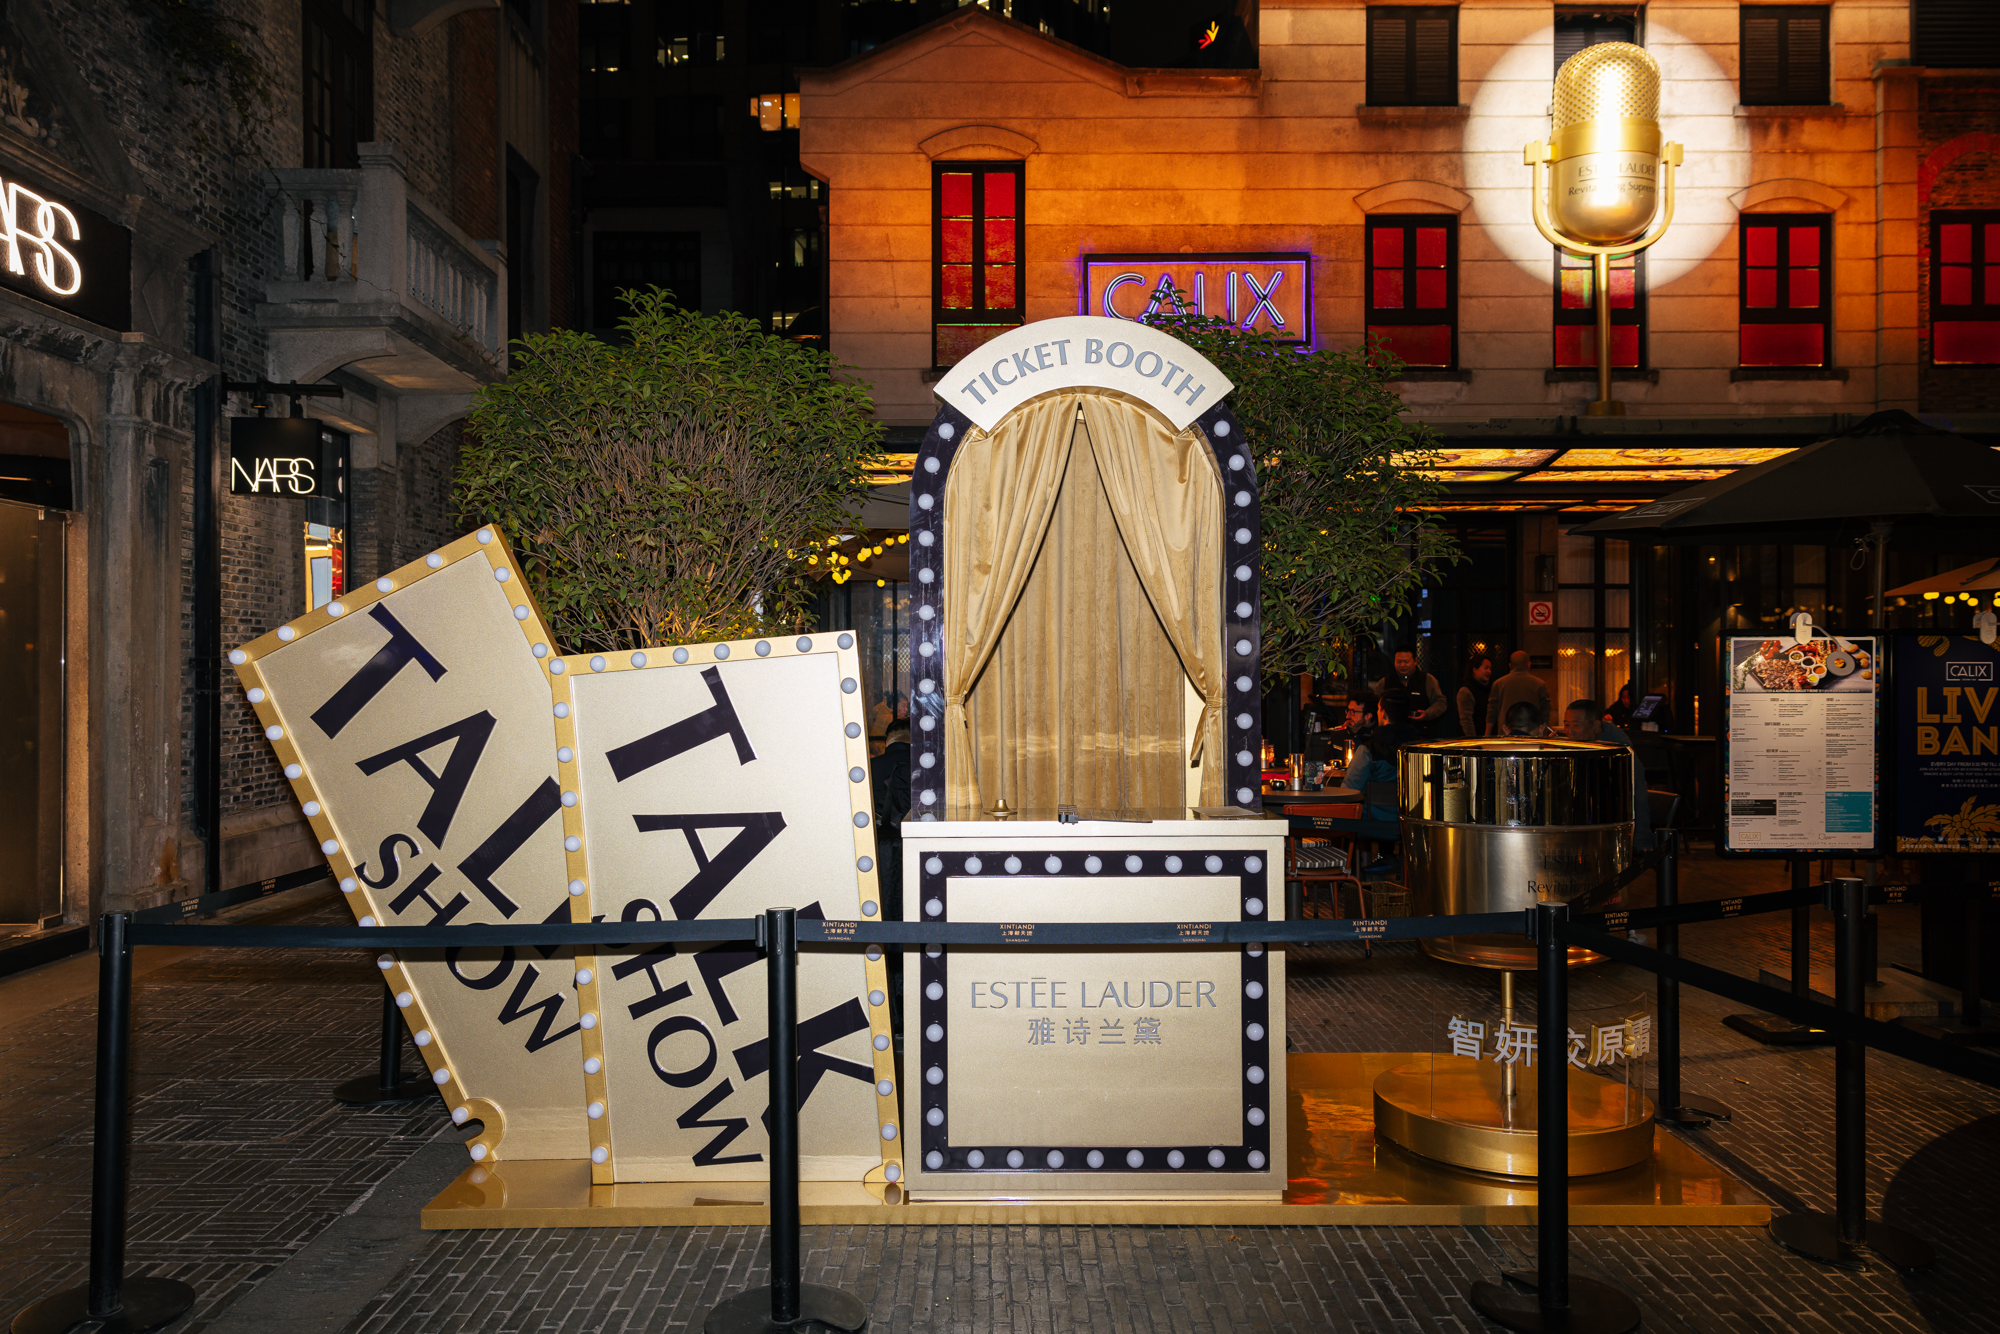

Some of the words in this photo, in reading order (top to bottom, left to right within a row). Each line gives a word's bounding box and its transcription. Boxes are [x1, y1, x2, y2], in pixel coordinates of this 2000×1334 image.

[1104, 272, 1285, 326] CALIX
[961, 339, 1071, 405] TICKET
[1085, 338, 1206, 406] BOOTH
[231, 456, 315, 494] NARS
[1950, 665, 1987, 677] CALIX
[1917, 687, 1999, 724] LIV
[1917, 726, 1998, 755] BAN
[1081, 981, 1217, 1009] LAUDER
[1028, 1017, 1162, 1046] 雅诗兰黛
